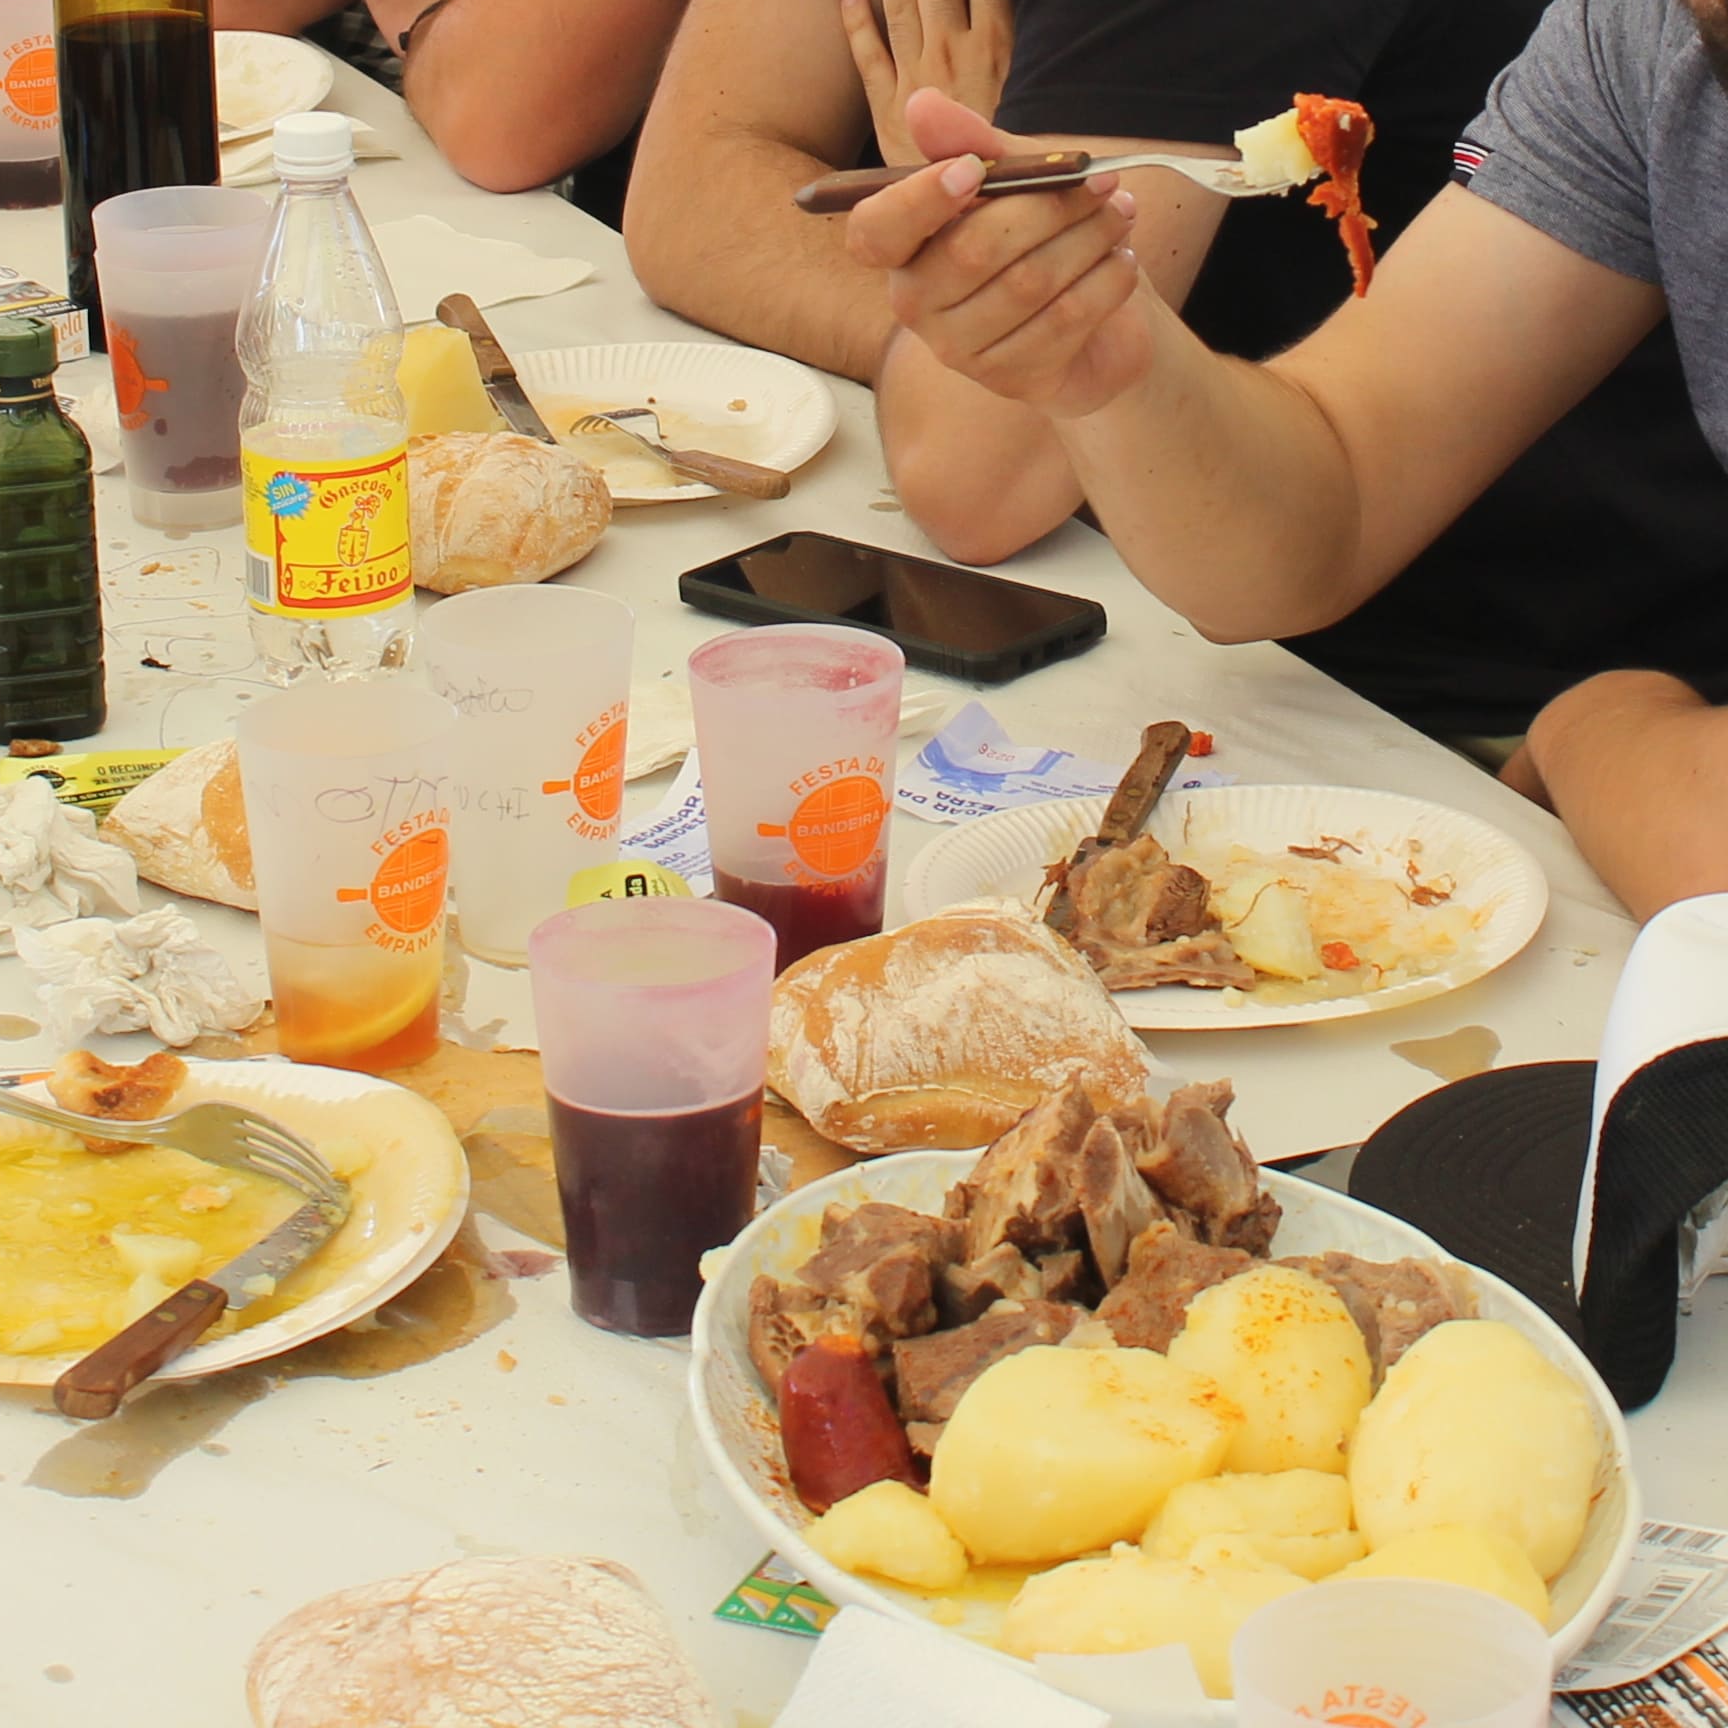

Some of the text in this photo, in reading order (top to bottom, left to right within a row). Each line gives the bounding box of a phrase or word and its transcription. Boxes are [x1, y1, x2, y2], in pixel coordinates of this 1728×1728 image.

[2, 33, 54, 62] FESTA
[271, 482, 297, 500] SIN
[315, 566, 399, 595] Feijoo
[789, 756, 886, 796] FESTA DA
[370, 809, 439, 856] FESTA
[796, 809, 881, 838] BANDEIRA
